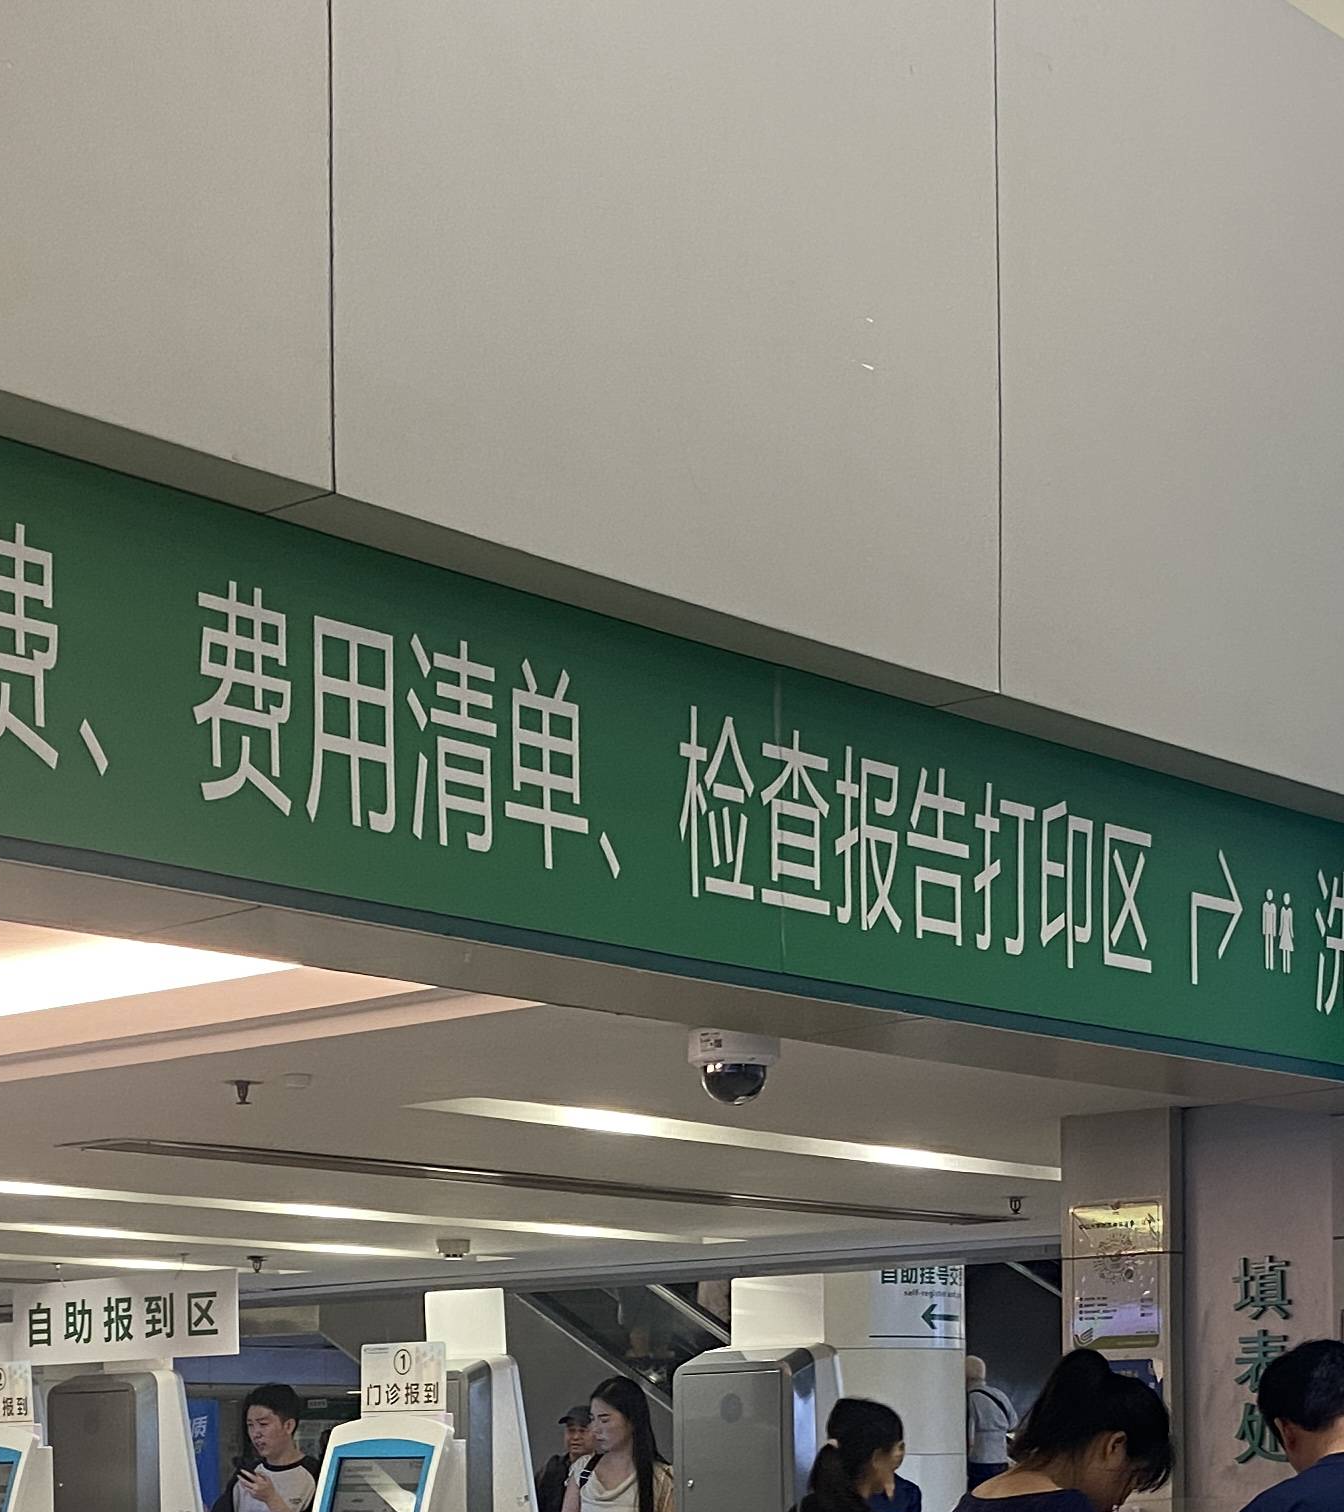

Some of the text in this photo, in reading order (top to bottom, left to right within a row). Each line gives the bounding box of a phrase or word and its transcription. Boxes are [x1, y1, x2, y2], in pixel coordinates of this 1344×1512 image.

[193, 580, 621, 879] 费用清单、
[678, 704, 1153, 975] 检查报告打印区
[28, 1290, 219, 1348] 自助报到区
[1232, 1255, 1292, 1464] 填表处
[367, 1382, 439, 1406] 门诊报到
